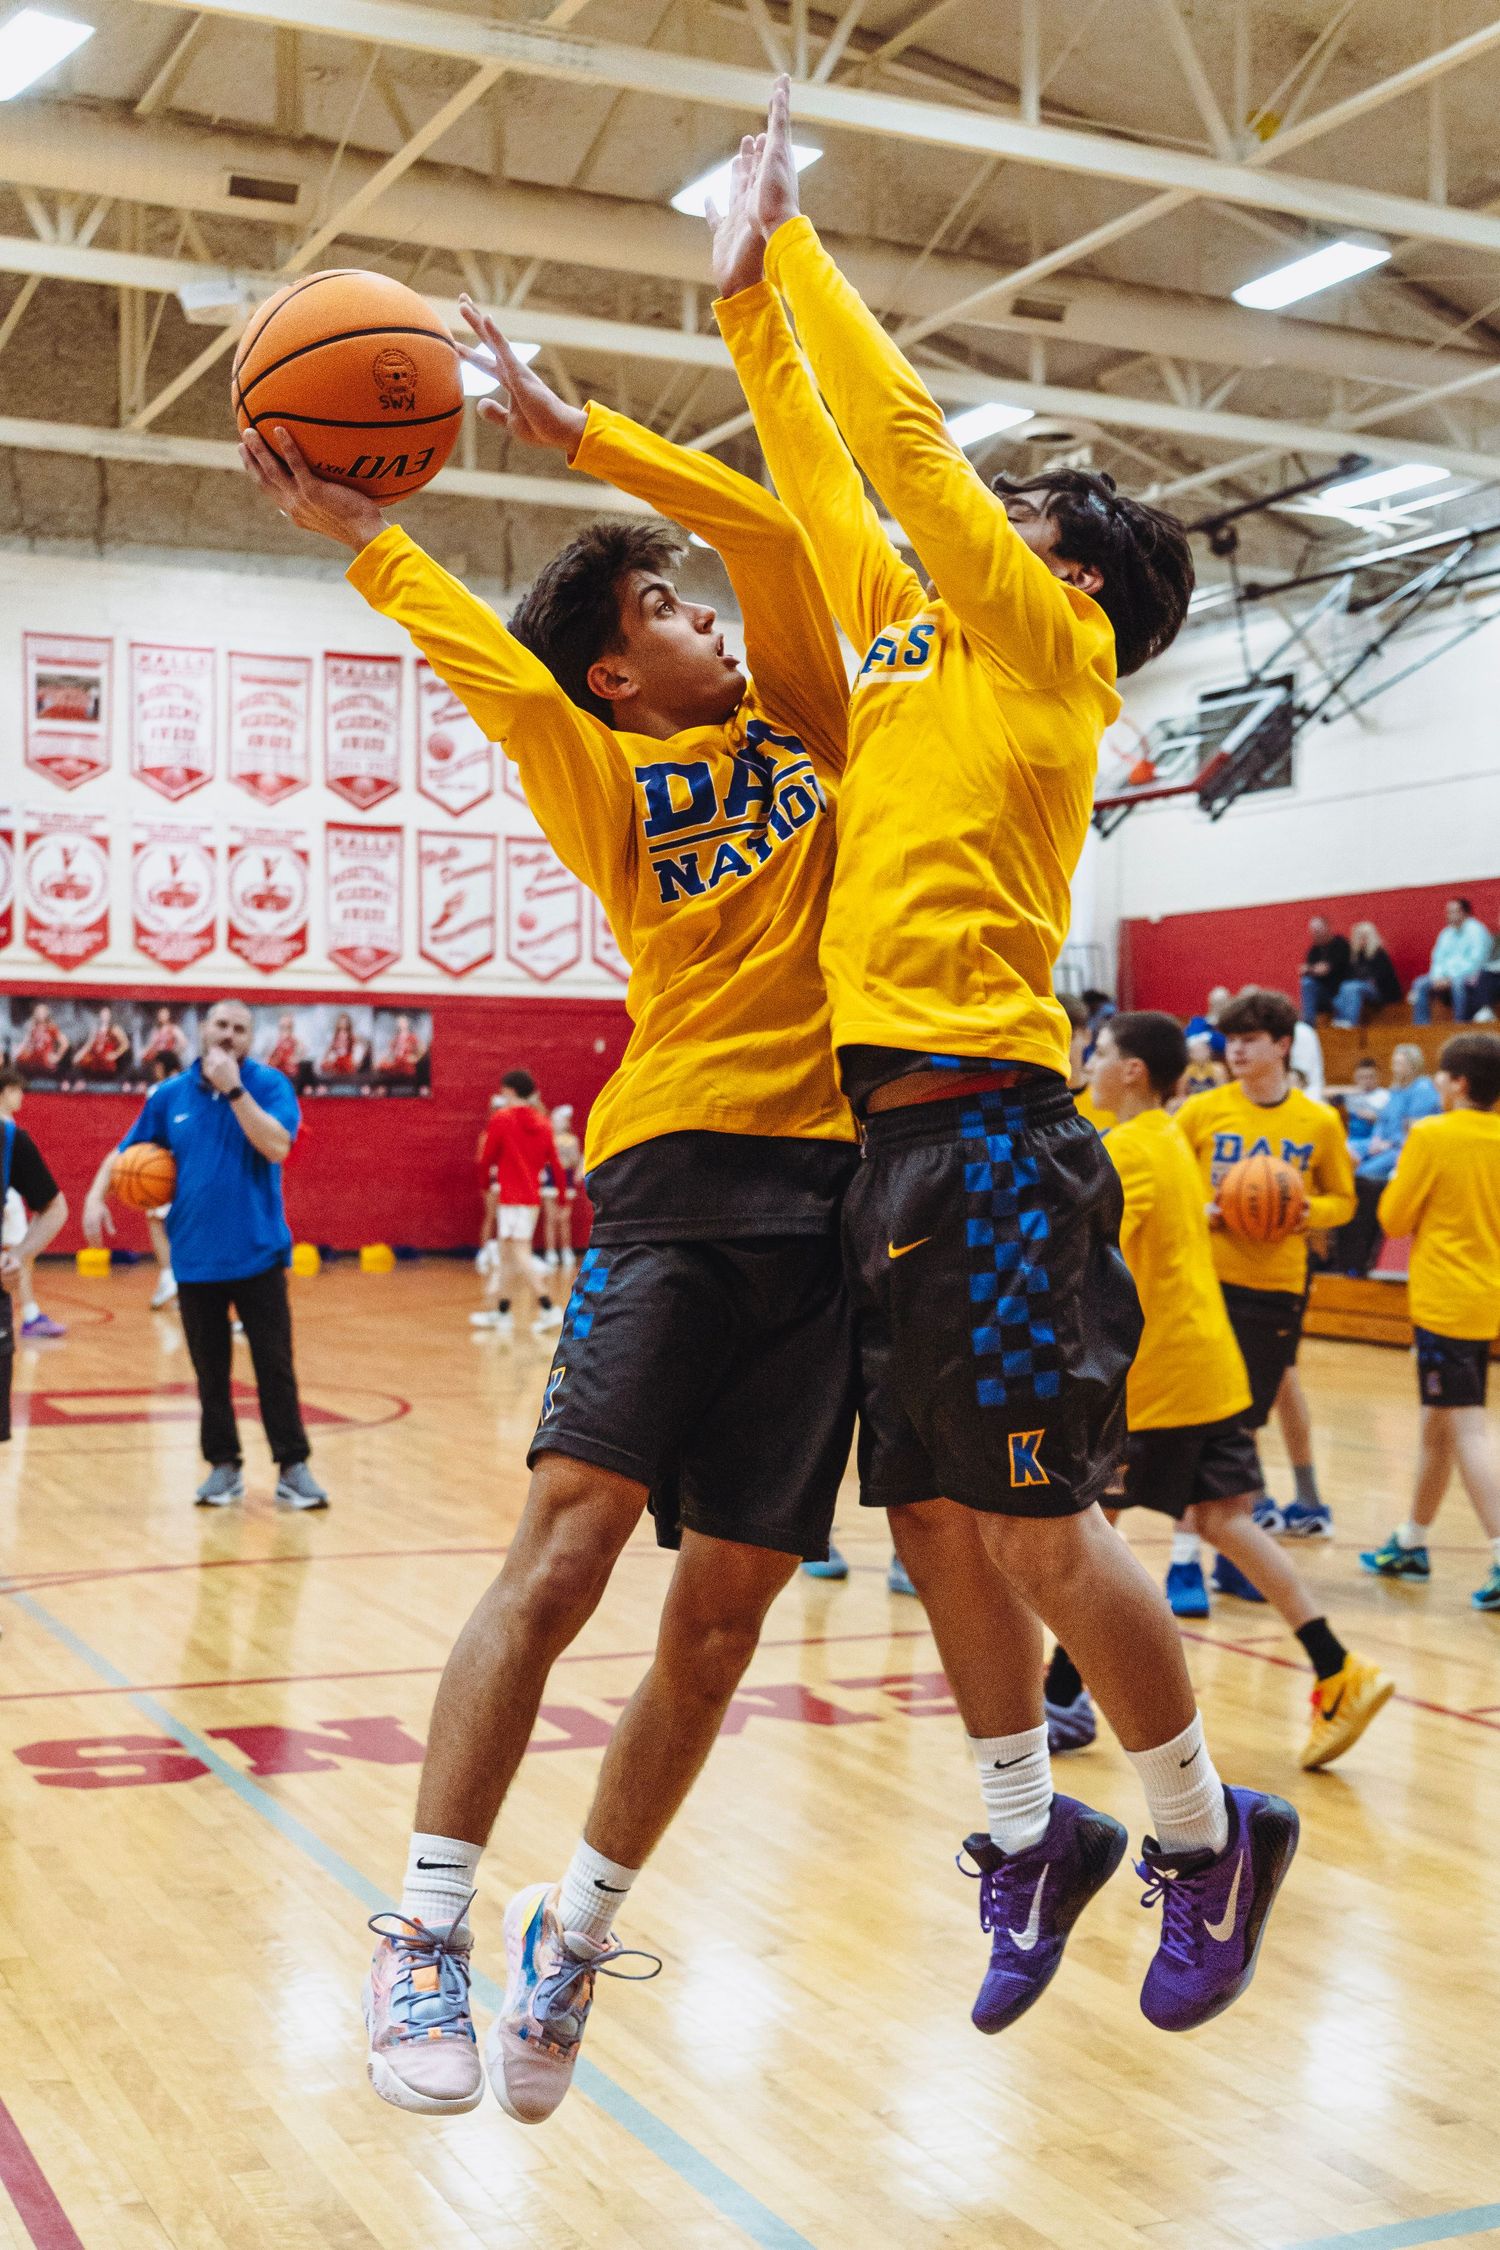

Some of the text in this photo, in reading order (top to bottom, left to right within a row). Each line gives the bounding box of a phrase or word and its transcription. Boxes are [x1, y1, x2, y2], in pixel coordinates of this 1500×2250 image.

[346, 447, 435, 479] EVO
[1213, 1133, 1315, 1172] DAM
[1009, 1428, 1051, 1488] K
